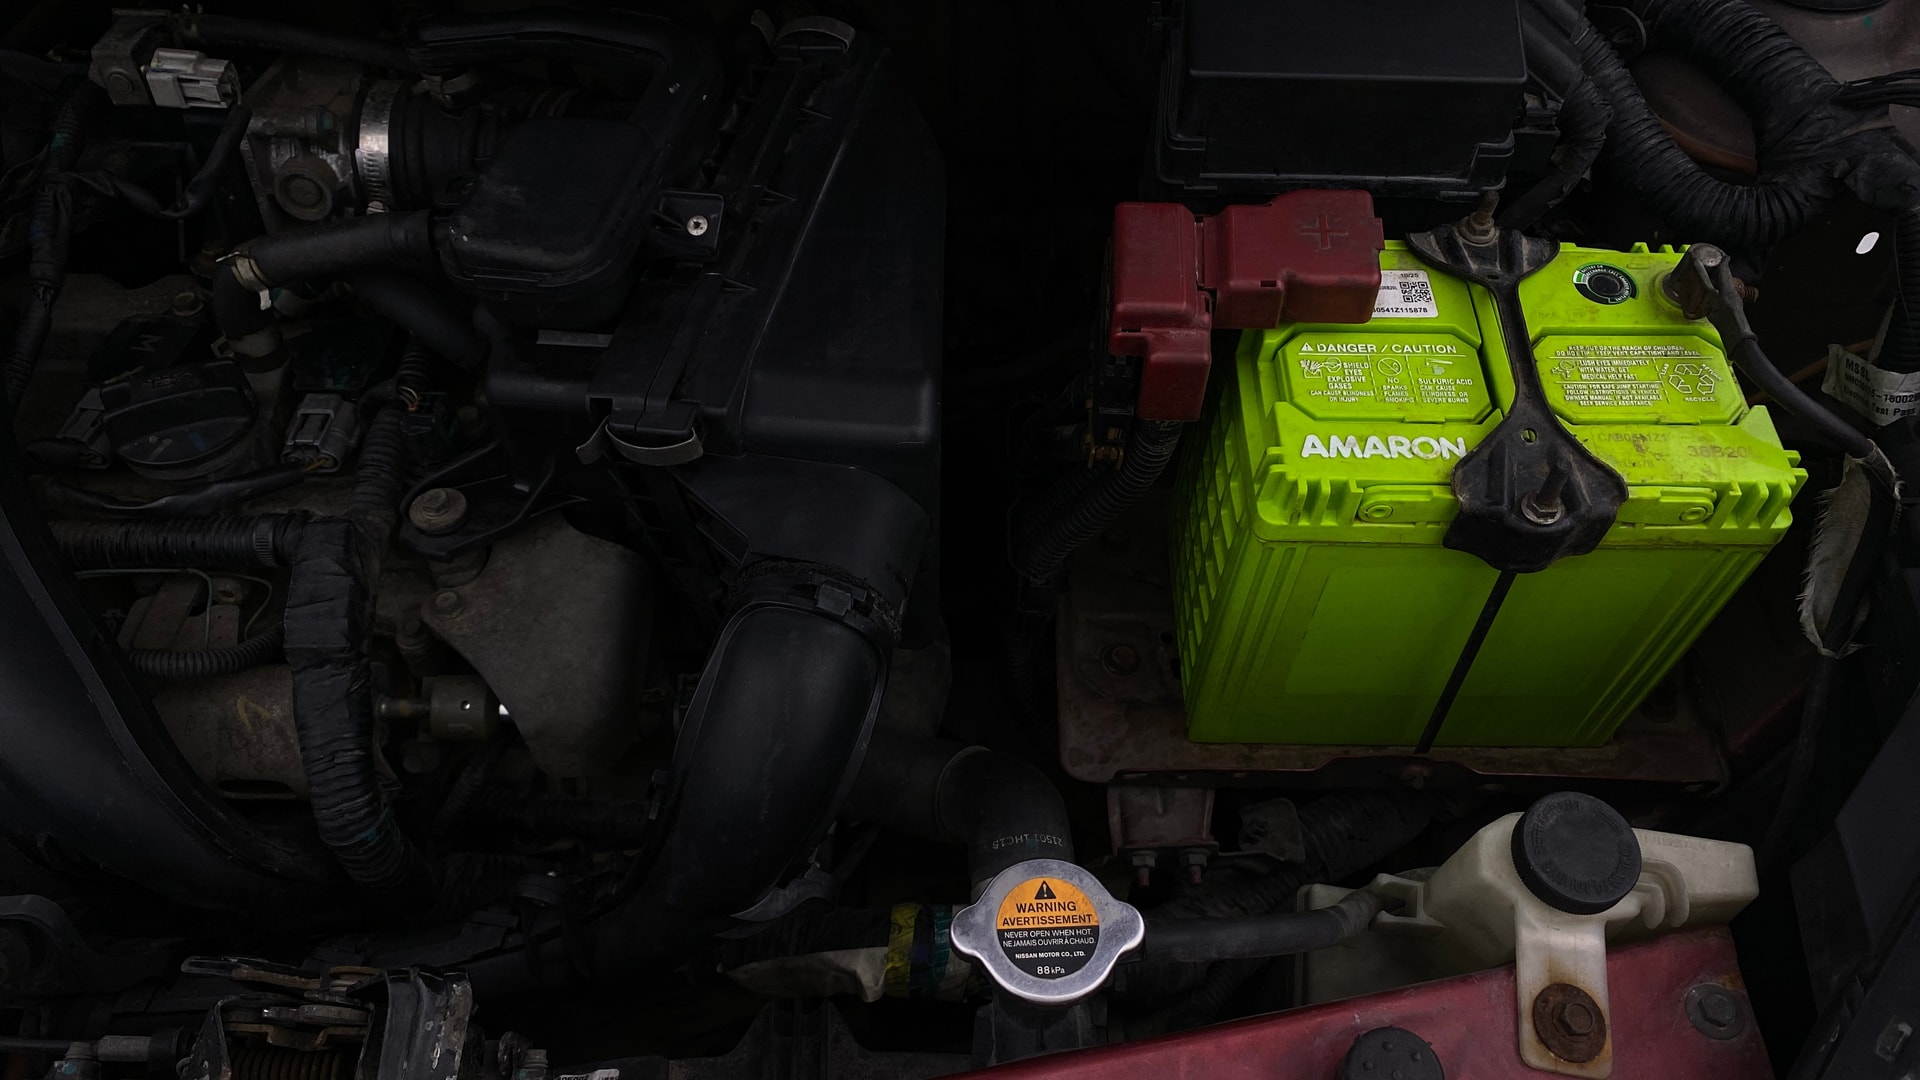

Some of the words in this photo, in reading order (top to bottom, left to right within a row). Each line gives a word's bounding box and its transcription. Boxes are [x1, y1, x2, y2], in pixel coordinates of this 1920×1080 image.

[1317, 343, 1377, 354] DANGER
[1381, 344, 1389, 353] /
[1392, 344, 1457, 354] CAUTION
[1344, 368, 1363, 376] EYES
[1327, 375, 1367, 383] EXPLOSIVE
[1328, 382, 1353, 390] GASES
[1301, 434, 1468, 460] AMARON
[1016, 901, 1077, 913] WARNING
[1002, 914, 1093, 927] AVERTISSEMENT
[1004, 931, 1028, 939] NEVER
[1029, 930, 1051, 938] OPEN
[1052, 929, 1075, 937] WHEN
[1076, 928, 1093, 936] HOT.
[1002, 940, 1013, 948] NE
[1013, 939, 1037, 948] JAMAIS
[1037, 938, 1064, 946] OUVRIR
[1069, 936, 1096, 945] CHAUD.
[1037, 965, 1050, 975] 88
[1051, 966, 1065, 974] kPa
